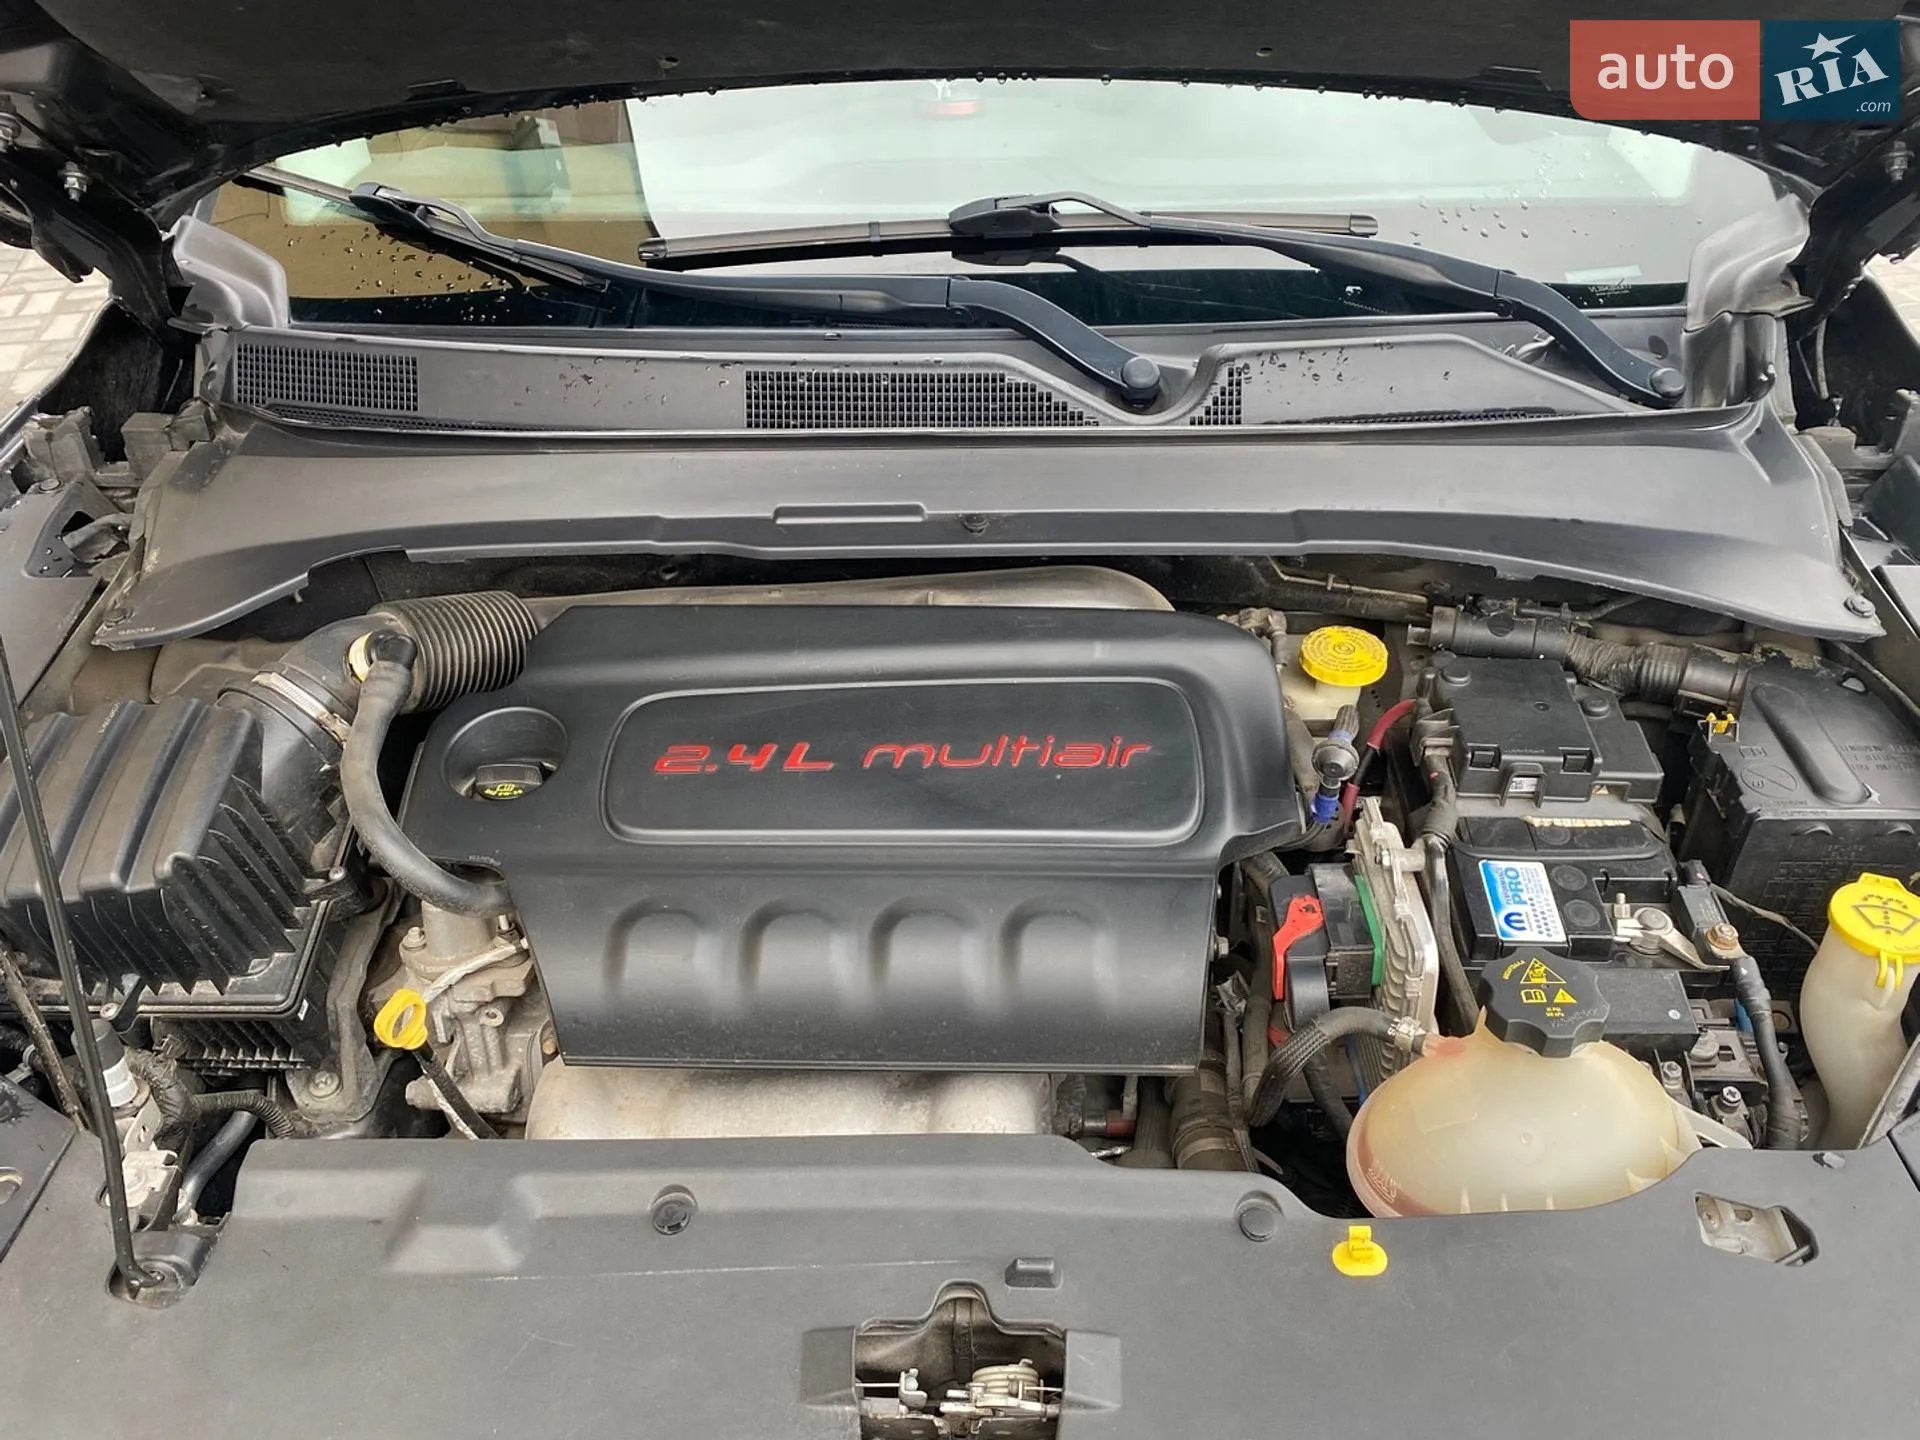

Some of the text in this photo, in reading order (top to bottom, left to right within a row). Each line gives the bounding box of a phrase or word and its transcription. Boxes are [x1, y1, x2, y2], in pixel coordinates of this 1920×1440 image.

[654, 734, 1152, 774] 2.4L multiair
[1504, 866, 1528, 905] PRO
